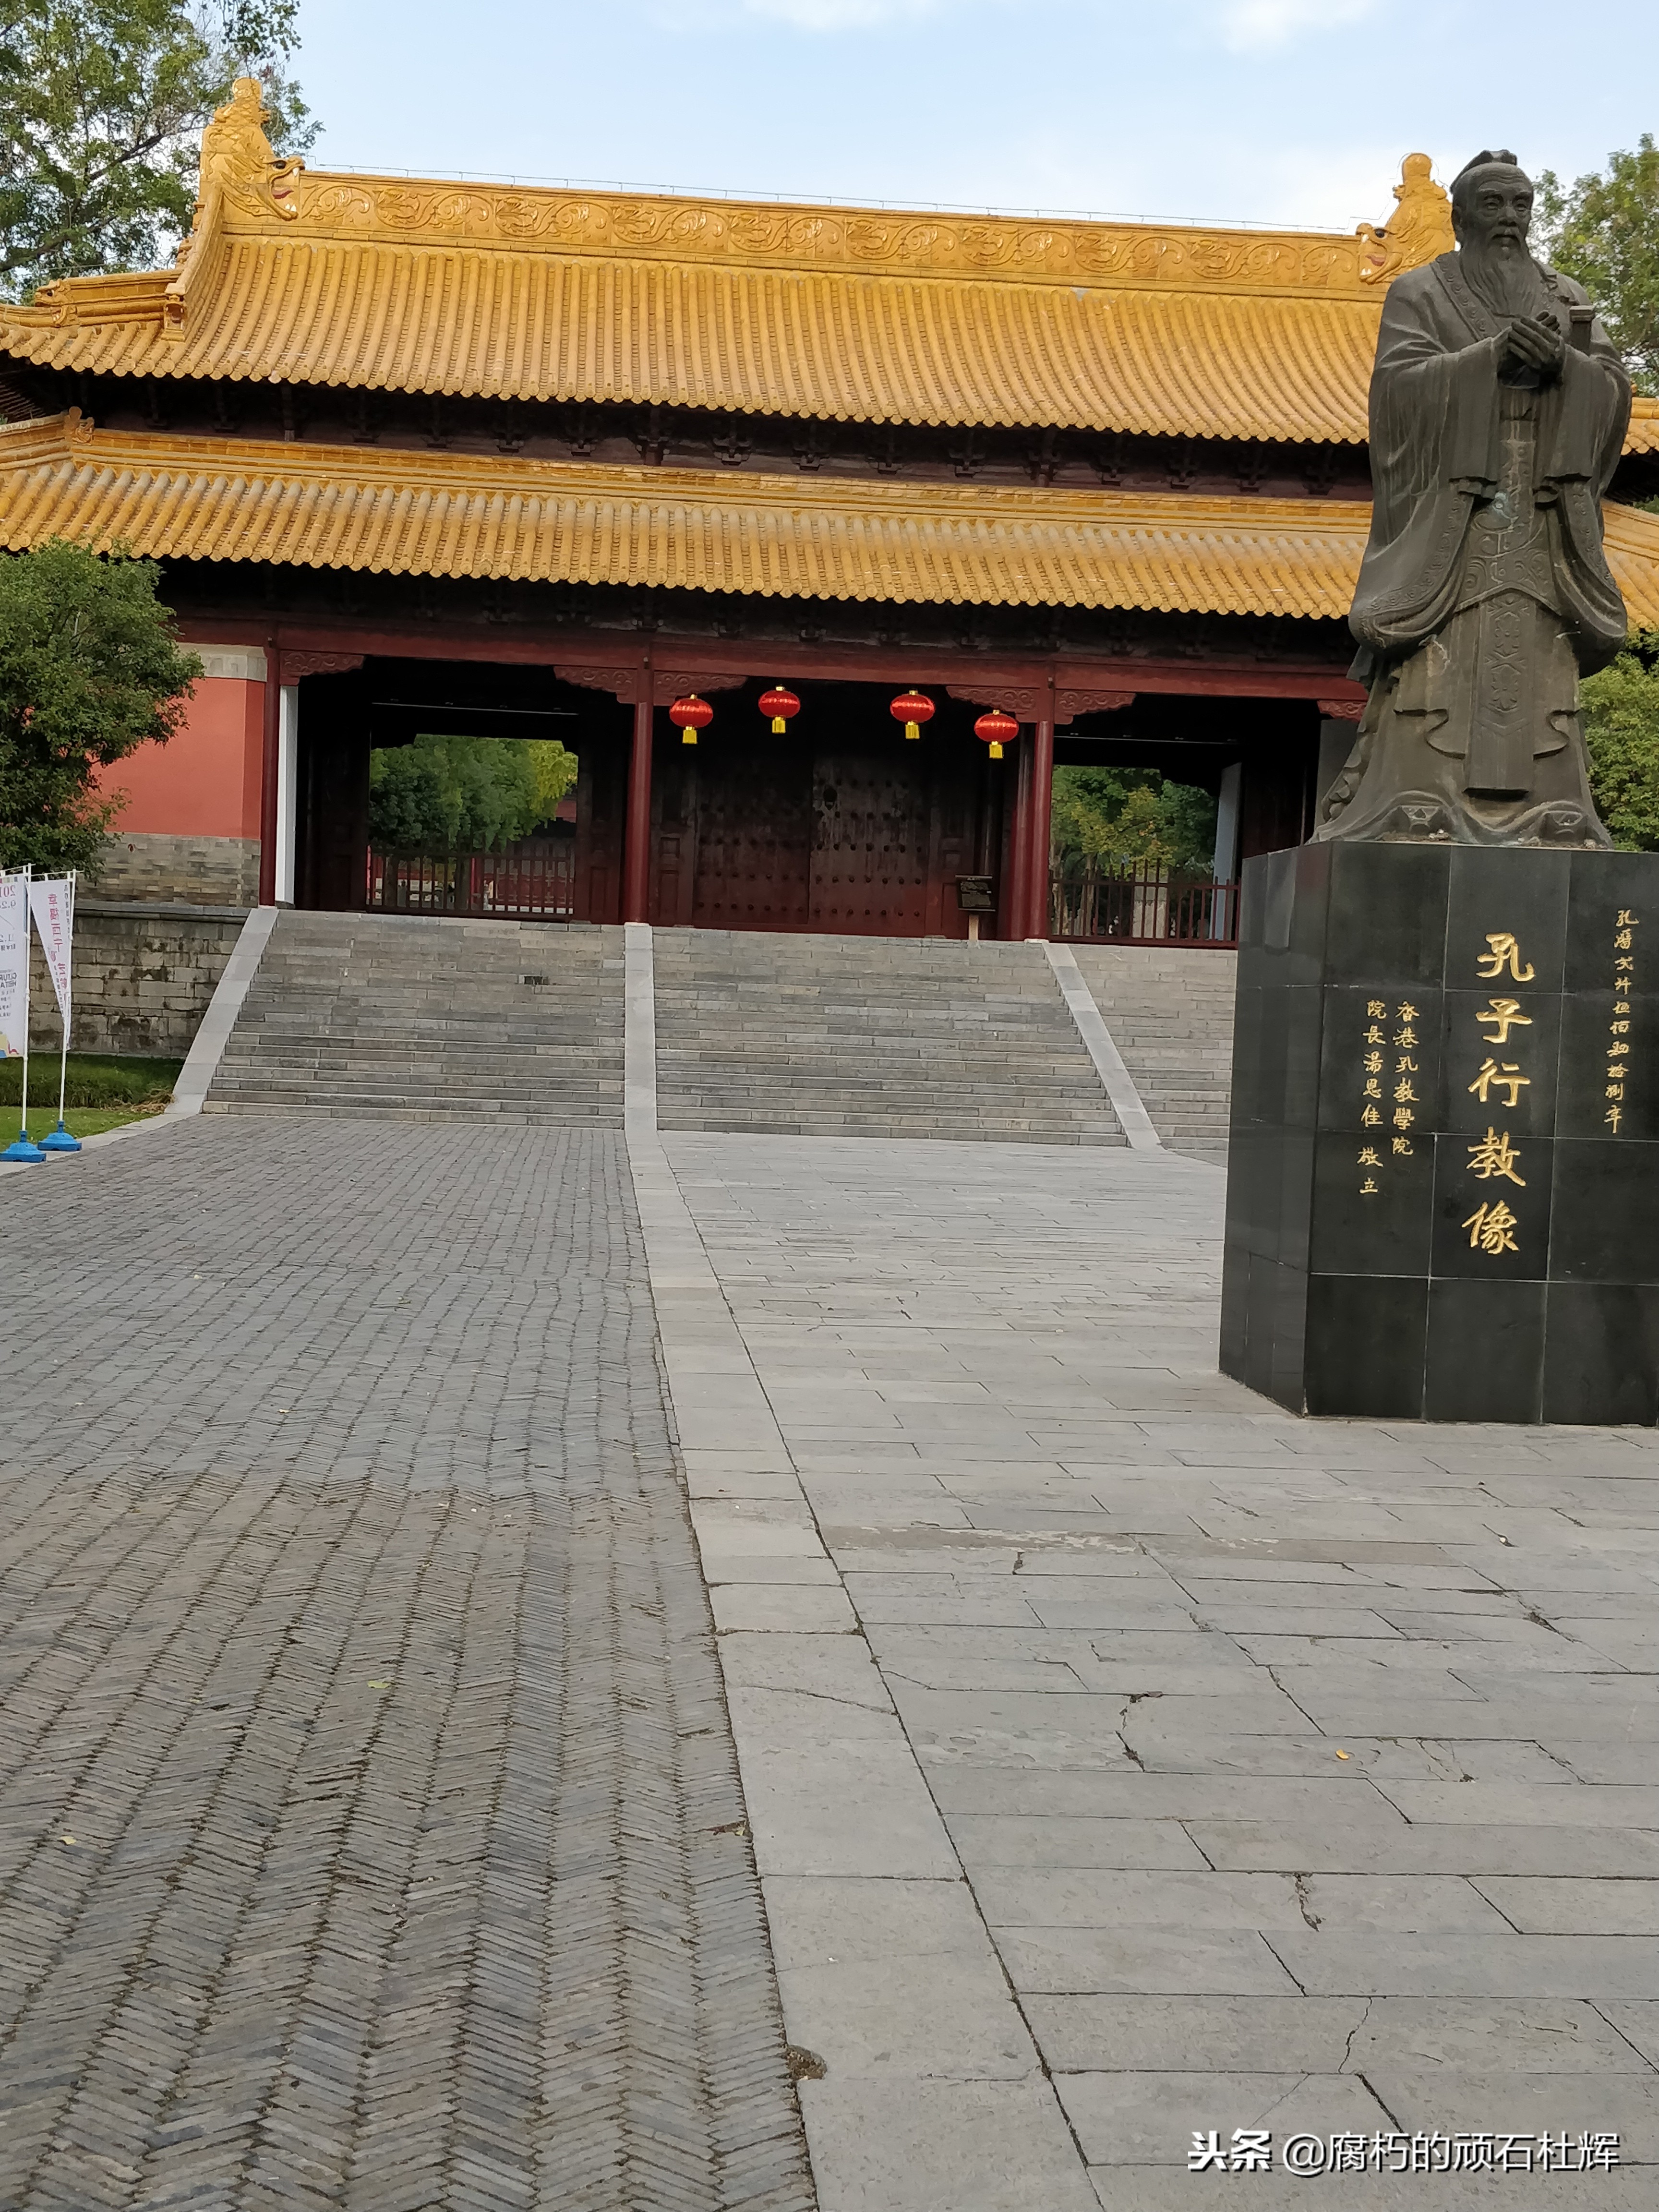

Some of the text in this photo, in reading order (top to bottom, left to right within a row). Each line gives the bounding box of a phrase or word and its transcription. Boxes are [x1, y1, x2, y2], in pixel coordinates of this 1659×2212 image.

[1392, 1001, 1419, 1155] 香港孔教學院
[1461, 932, 1536, 1255] 孔子行教像
